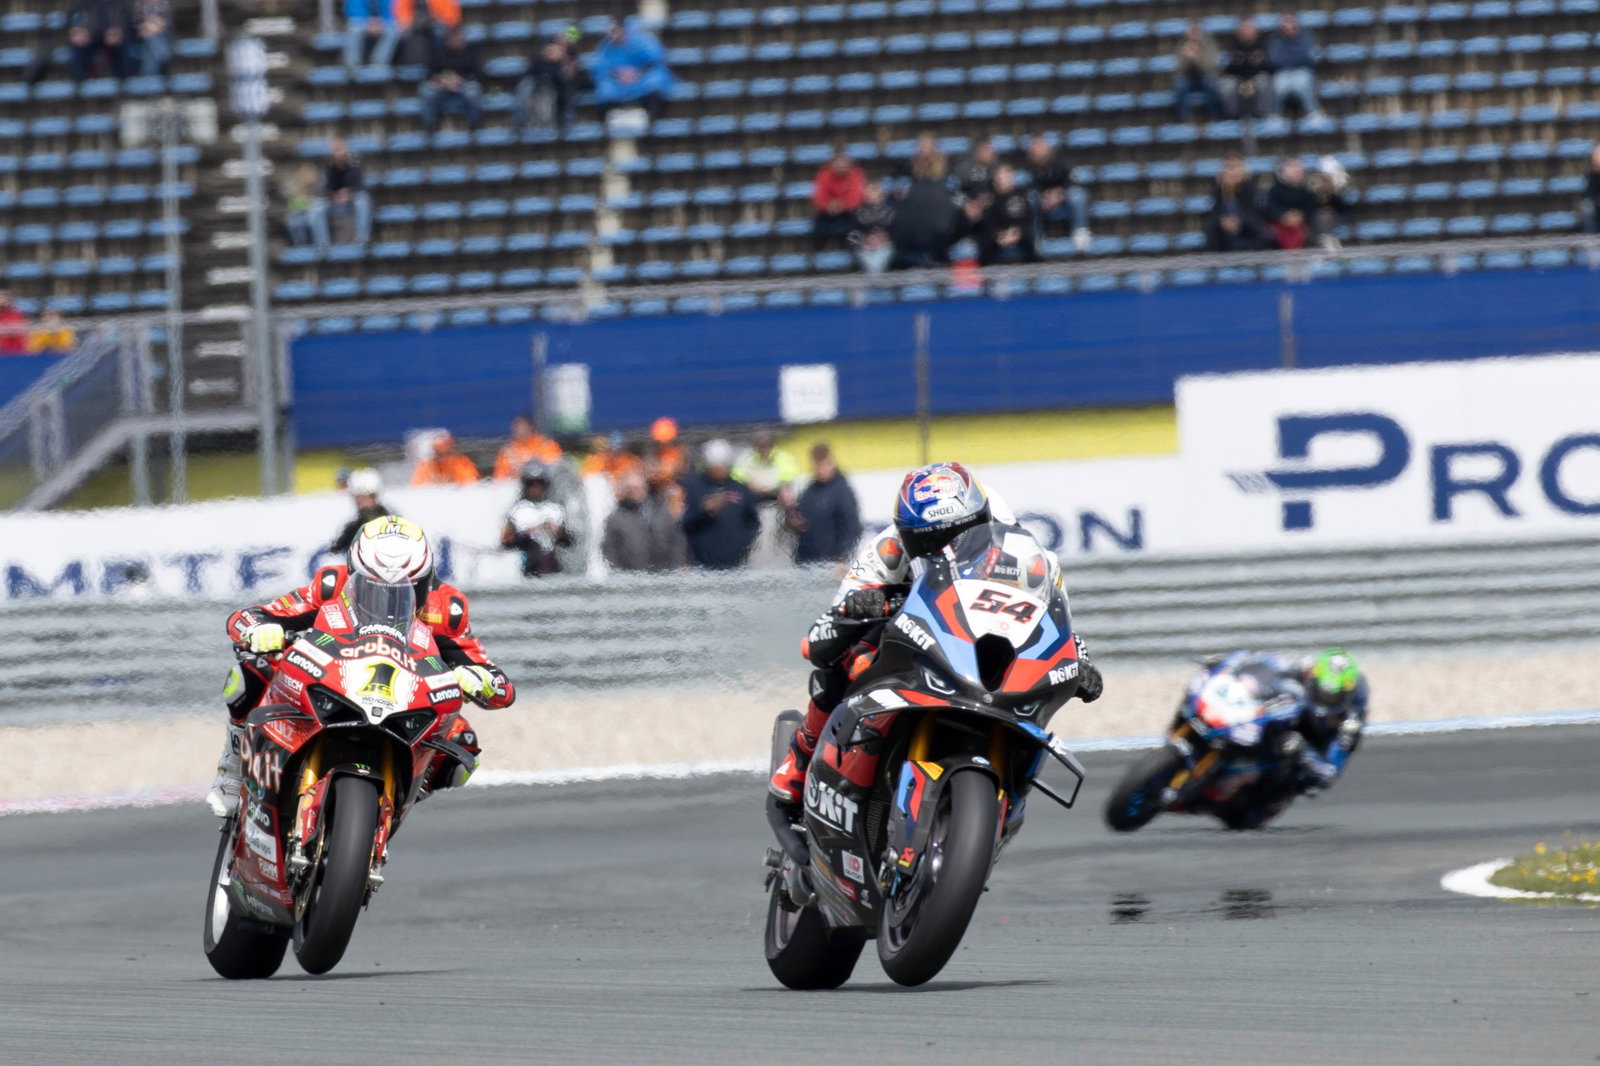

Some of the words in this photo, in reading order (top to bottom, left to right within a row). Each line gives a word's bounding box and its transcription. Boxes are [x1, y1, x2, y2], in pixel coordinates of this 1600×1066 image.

[927, 505, 954, 519] SHOEI
[935, 517, 952, 530] YOU
[969, 588, 1039, 625] 54
[358, 623, 407, 645] CARRERA
[287, 650, 323, 678] Lenovo
[339, 636, 417, 672] aruba.it
[429, 687, 460, 703] Lenovo
